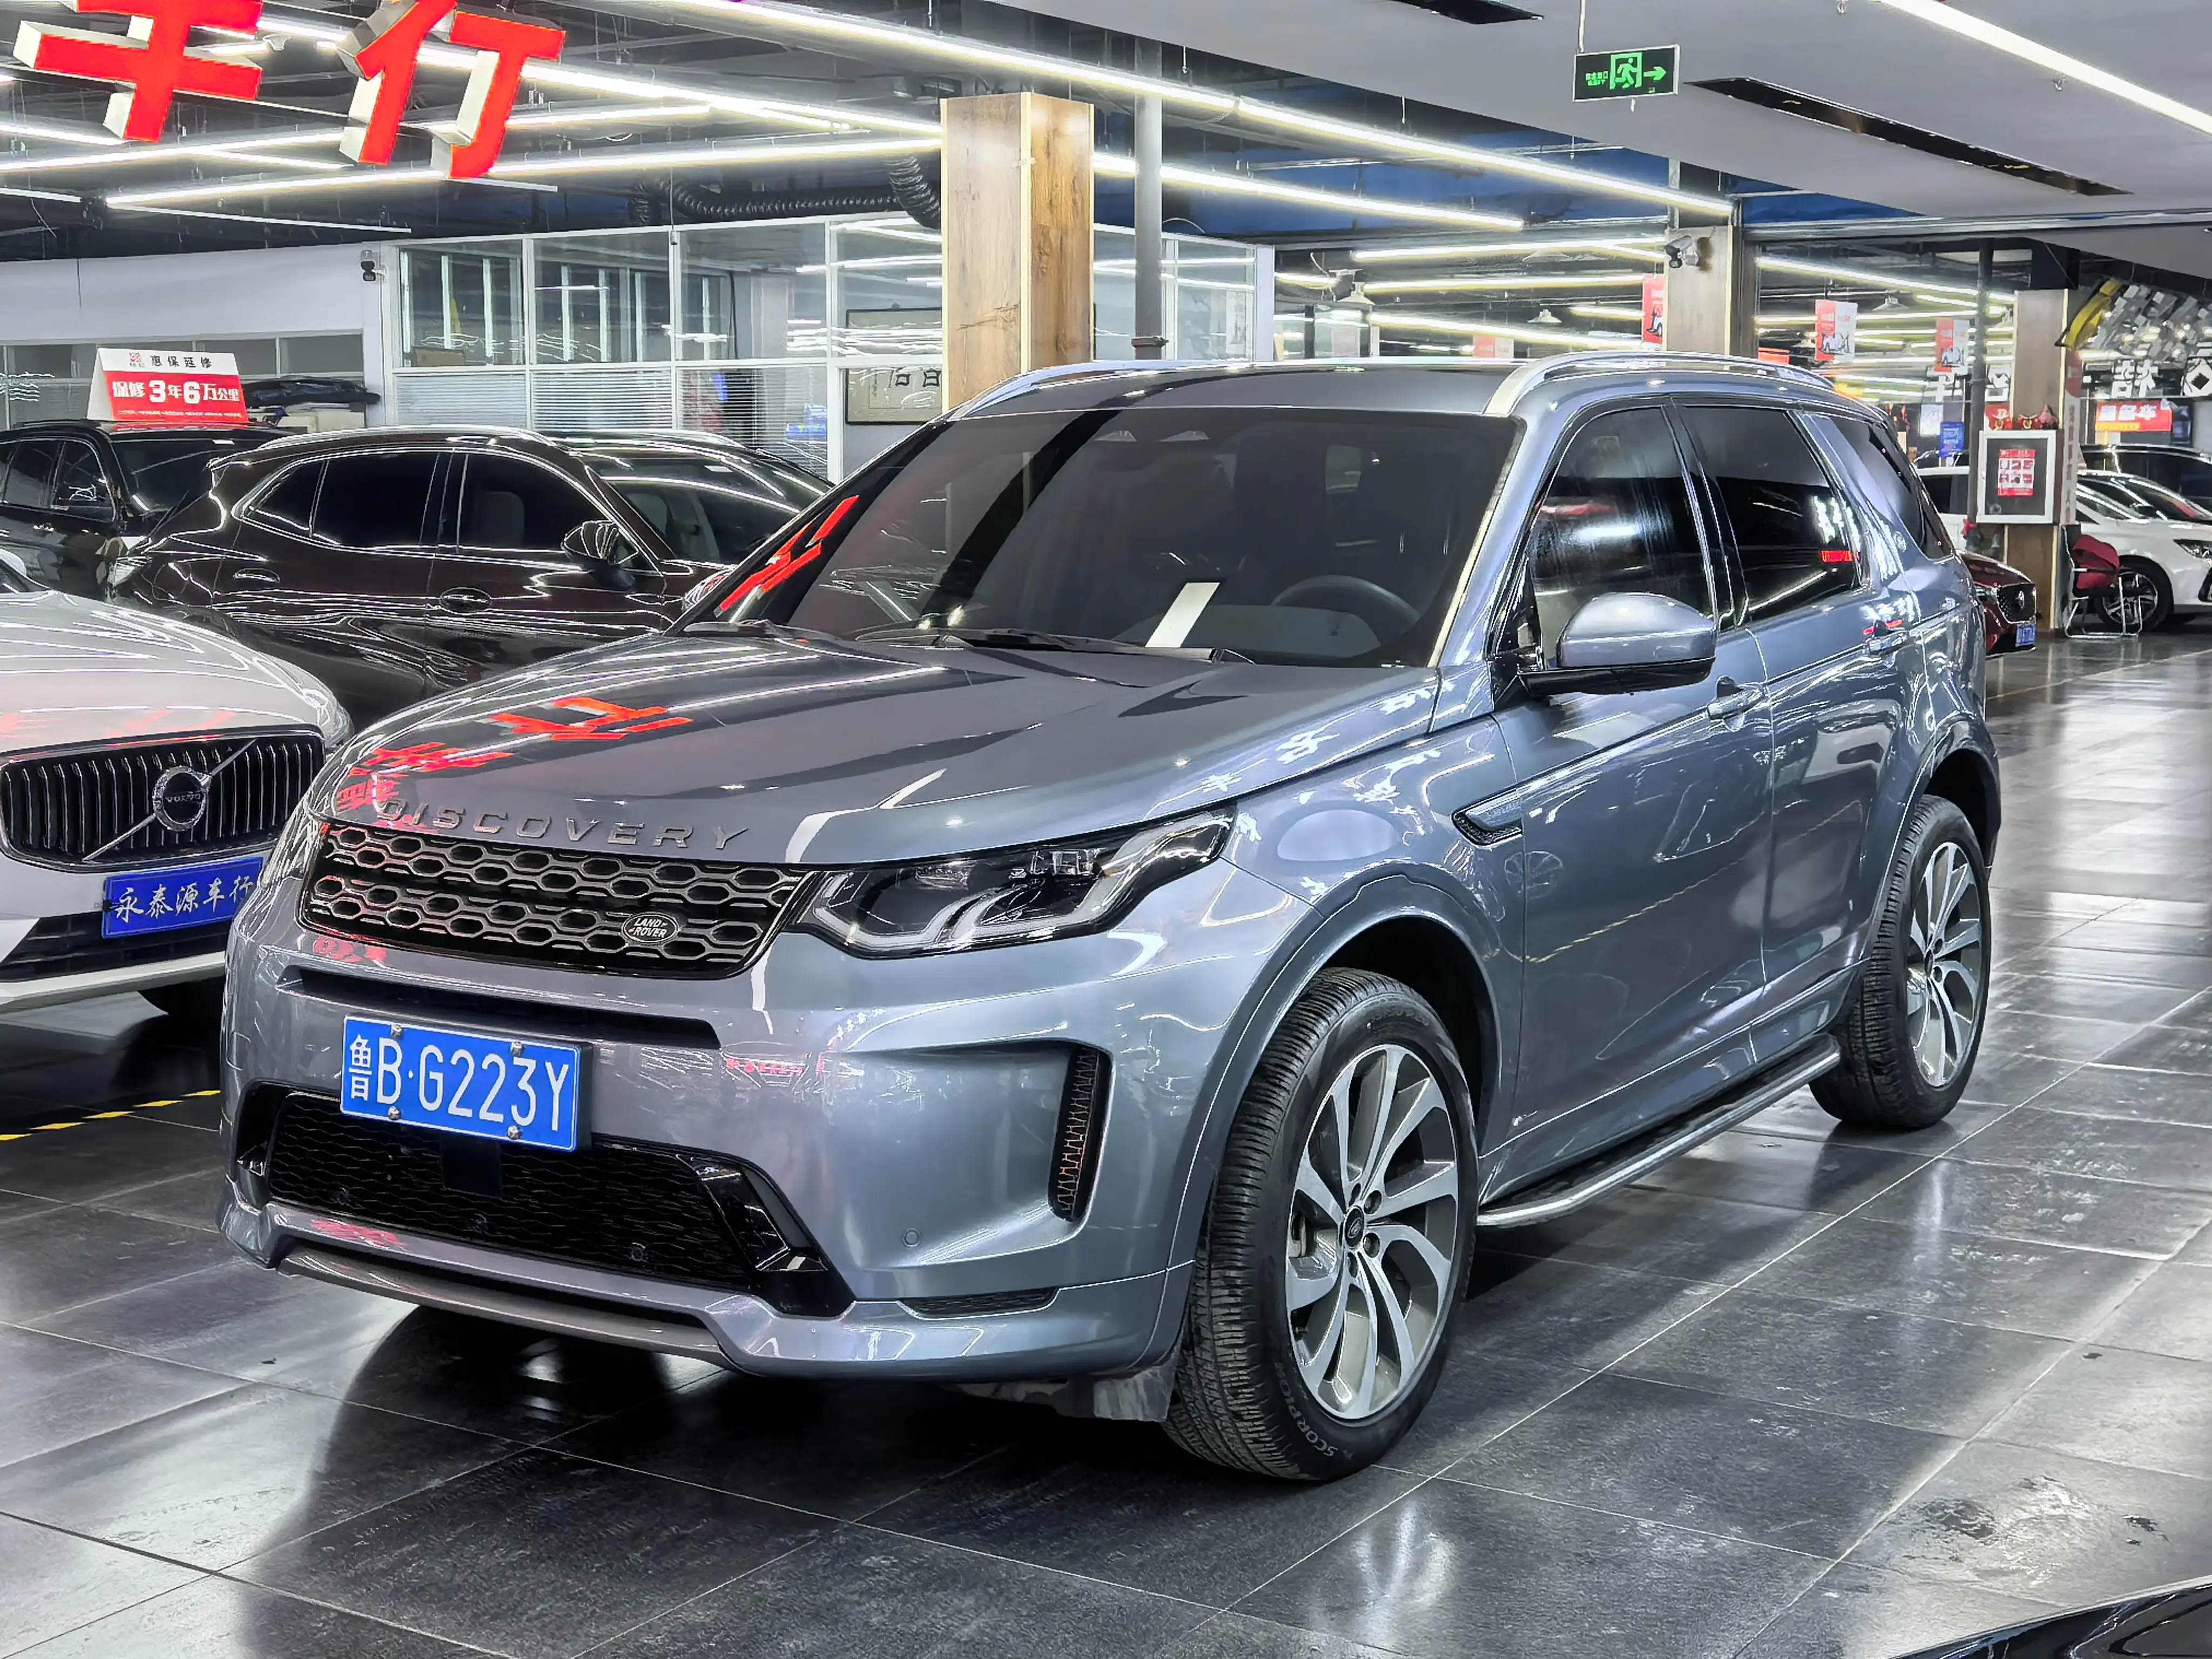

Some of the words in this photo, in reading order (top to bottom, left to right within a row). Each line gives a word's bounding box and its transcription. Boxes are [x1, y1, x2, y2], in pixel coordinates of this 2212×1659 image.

[376, 799, 749, 850] DISCOVERY
[633, 918, 662, 927] LAND
[632, 926, 667, 938] ROVER
